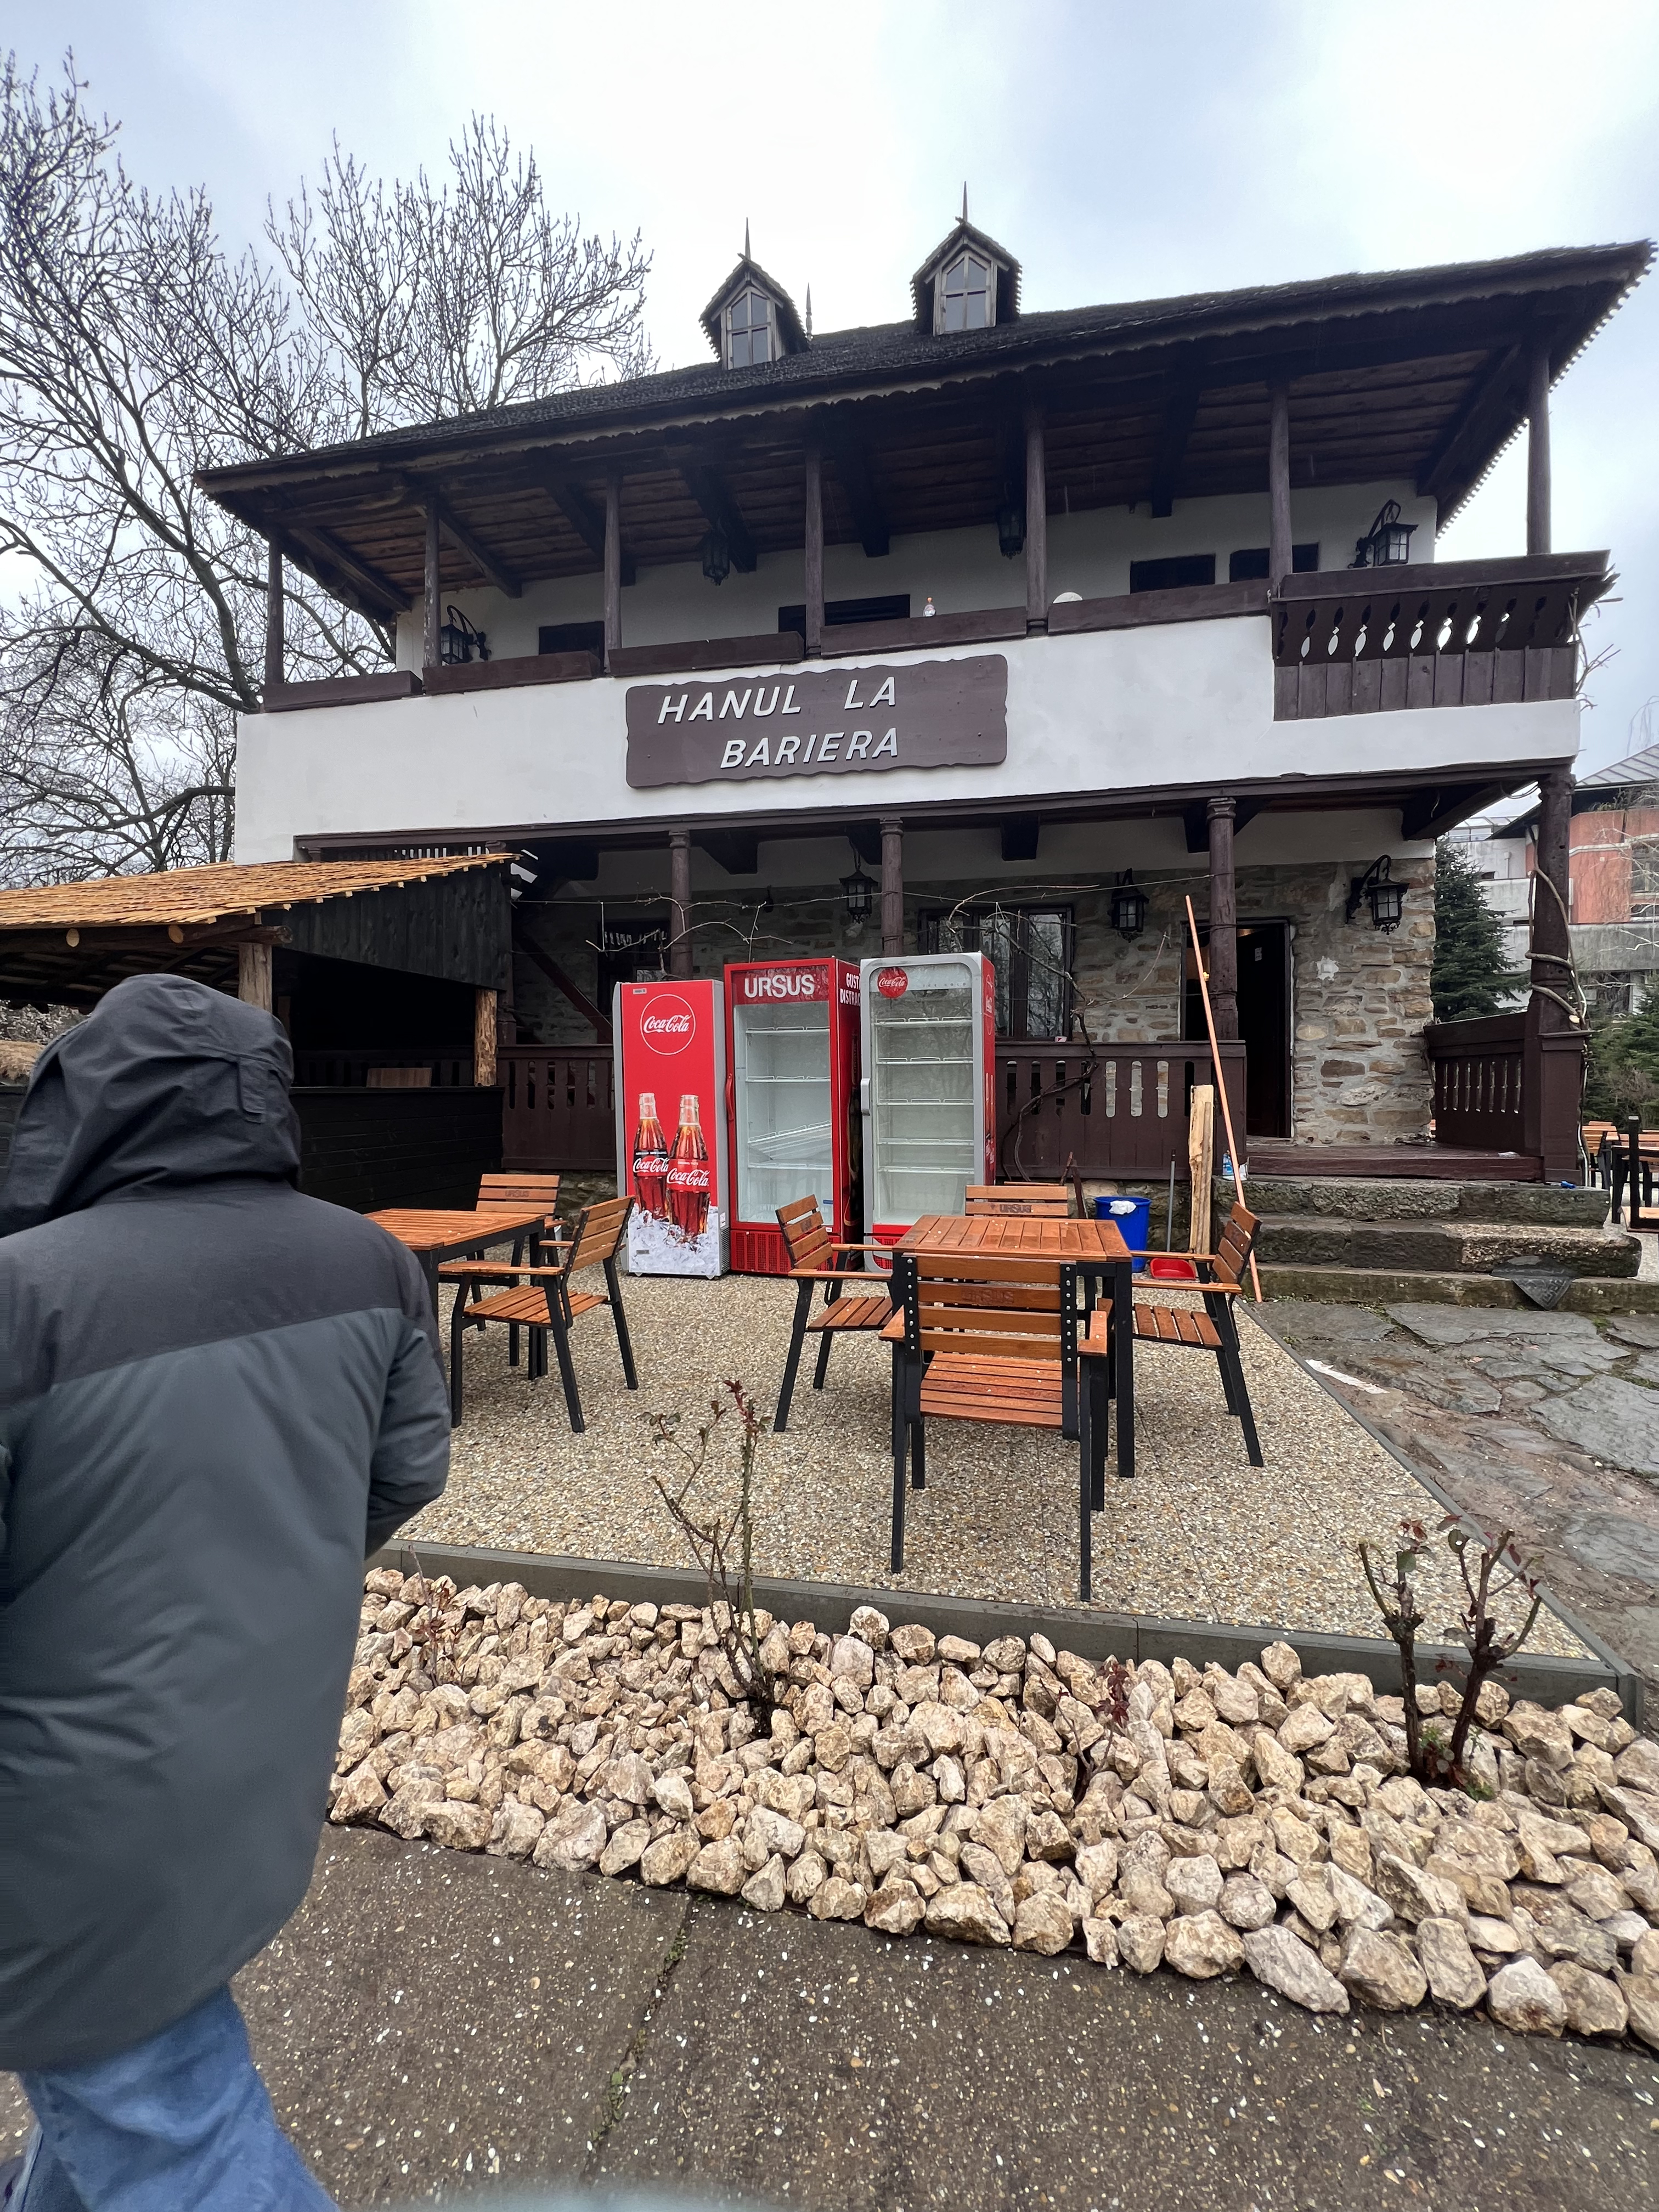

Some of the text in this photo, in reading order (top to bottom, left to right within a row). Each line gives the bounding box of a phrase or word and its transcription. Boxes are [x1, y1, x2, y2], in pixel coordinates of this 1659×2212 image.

[658, 676, 896, 724] HANUL LA
[720, 727, 899, 769] BARIERA
[744, 974, 815, 998] URSUS
[644, 1014, 692, 1034] Coca-Cola
[633, 1157, 670, 1173] Coca-Cola
[667, 1167, 710, 1187] Coca-Cola
[999, 1204, 1032, 1213] URSUS
